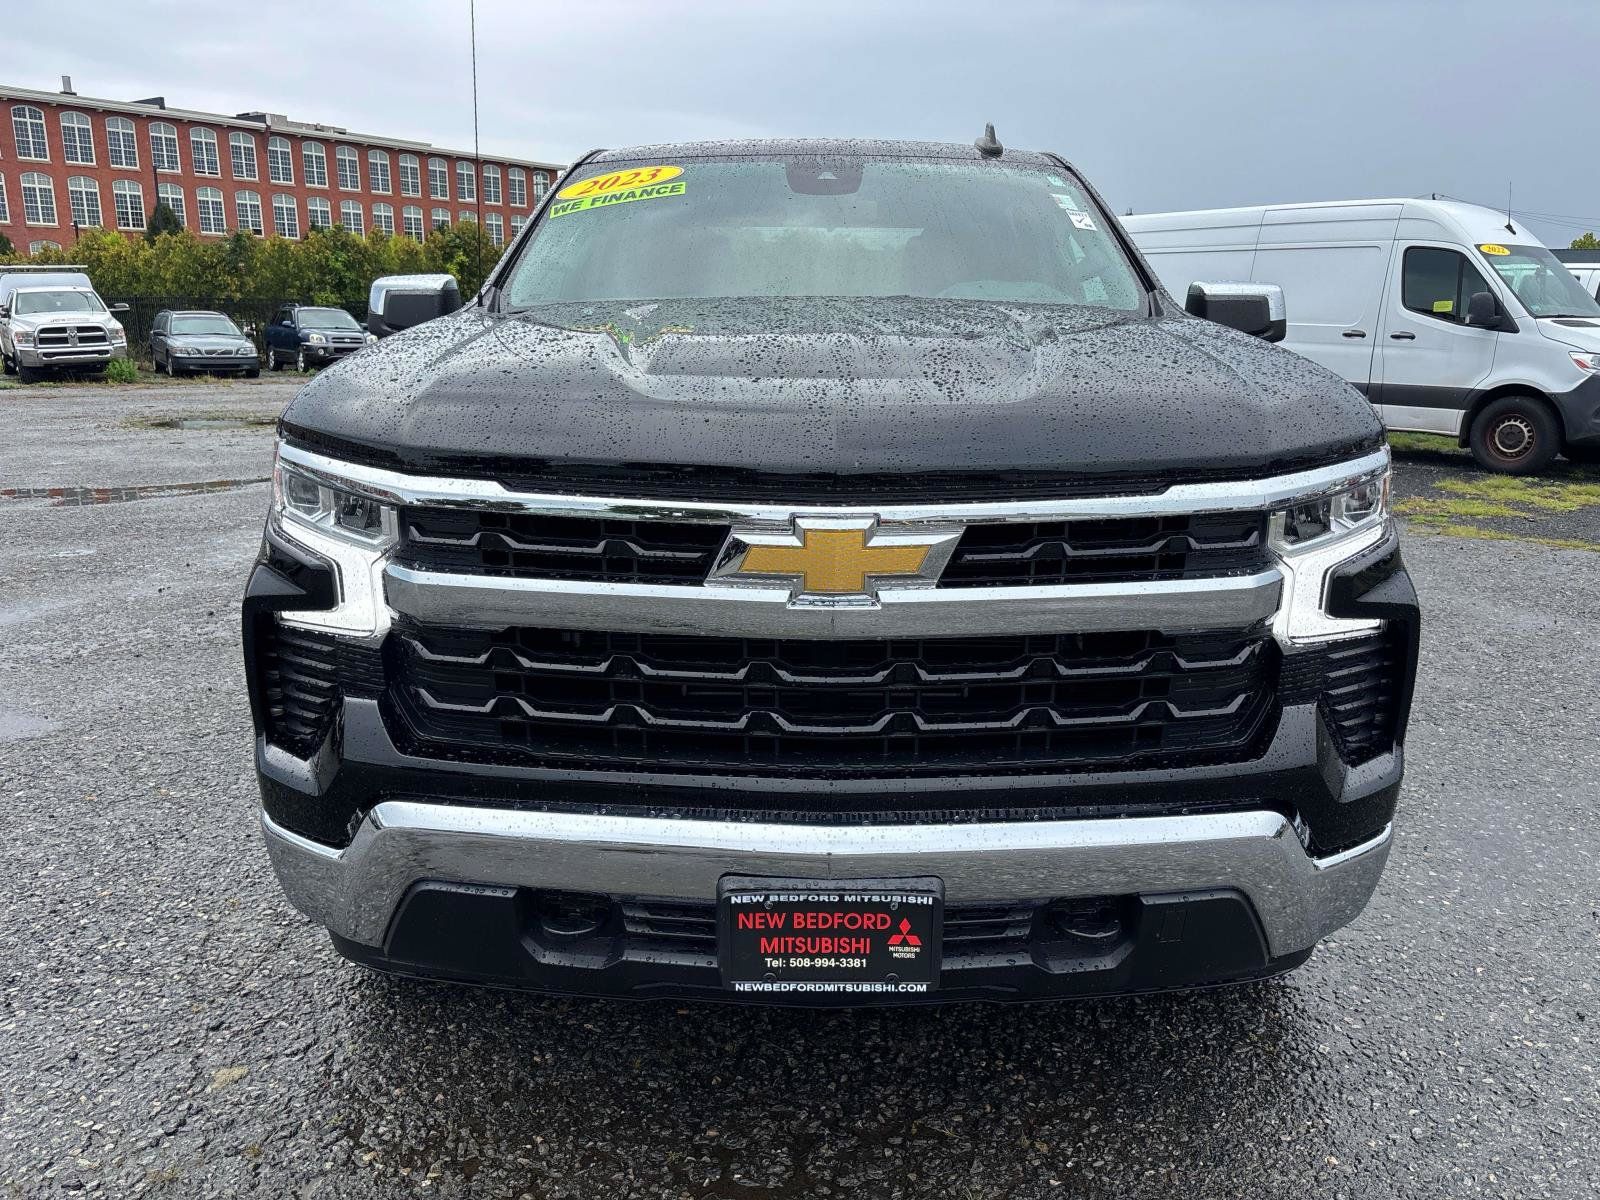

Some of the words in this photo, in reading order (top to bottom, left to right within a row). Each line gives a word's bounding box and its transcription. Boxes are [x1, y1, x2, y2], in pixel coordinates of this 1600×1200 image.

[575, 168, 663, 196] 2023
[553, 200, 581, 215] WE
[590, 183, 683, 206] FINANCE
[731, 895, 765, 904] NEW
[769, 894, 840, 902] BEDFORD
[844, 894, 933, 905] MITSUBISHI
[738, 912, 785, 929] NEW
[793, 912, 892, 930] BEDFORD
[760, 937, 871, 954] MITSUBISHI
[765, 958, 786, 968] Tel:
[789, 958, 867, 968] 508-994-3381
[735, 983, 927, 992] NEWBEDFORDMITSUBISHI.COM
